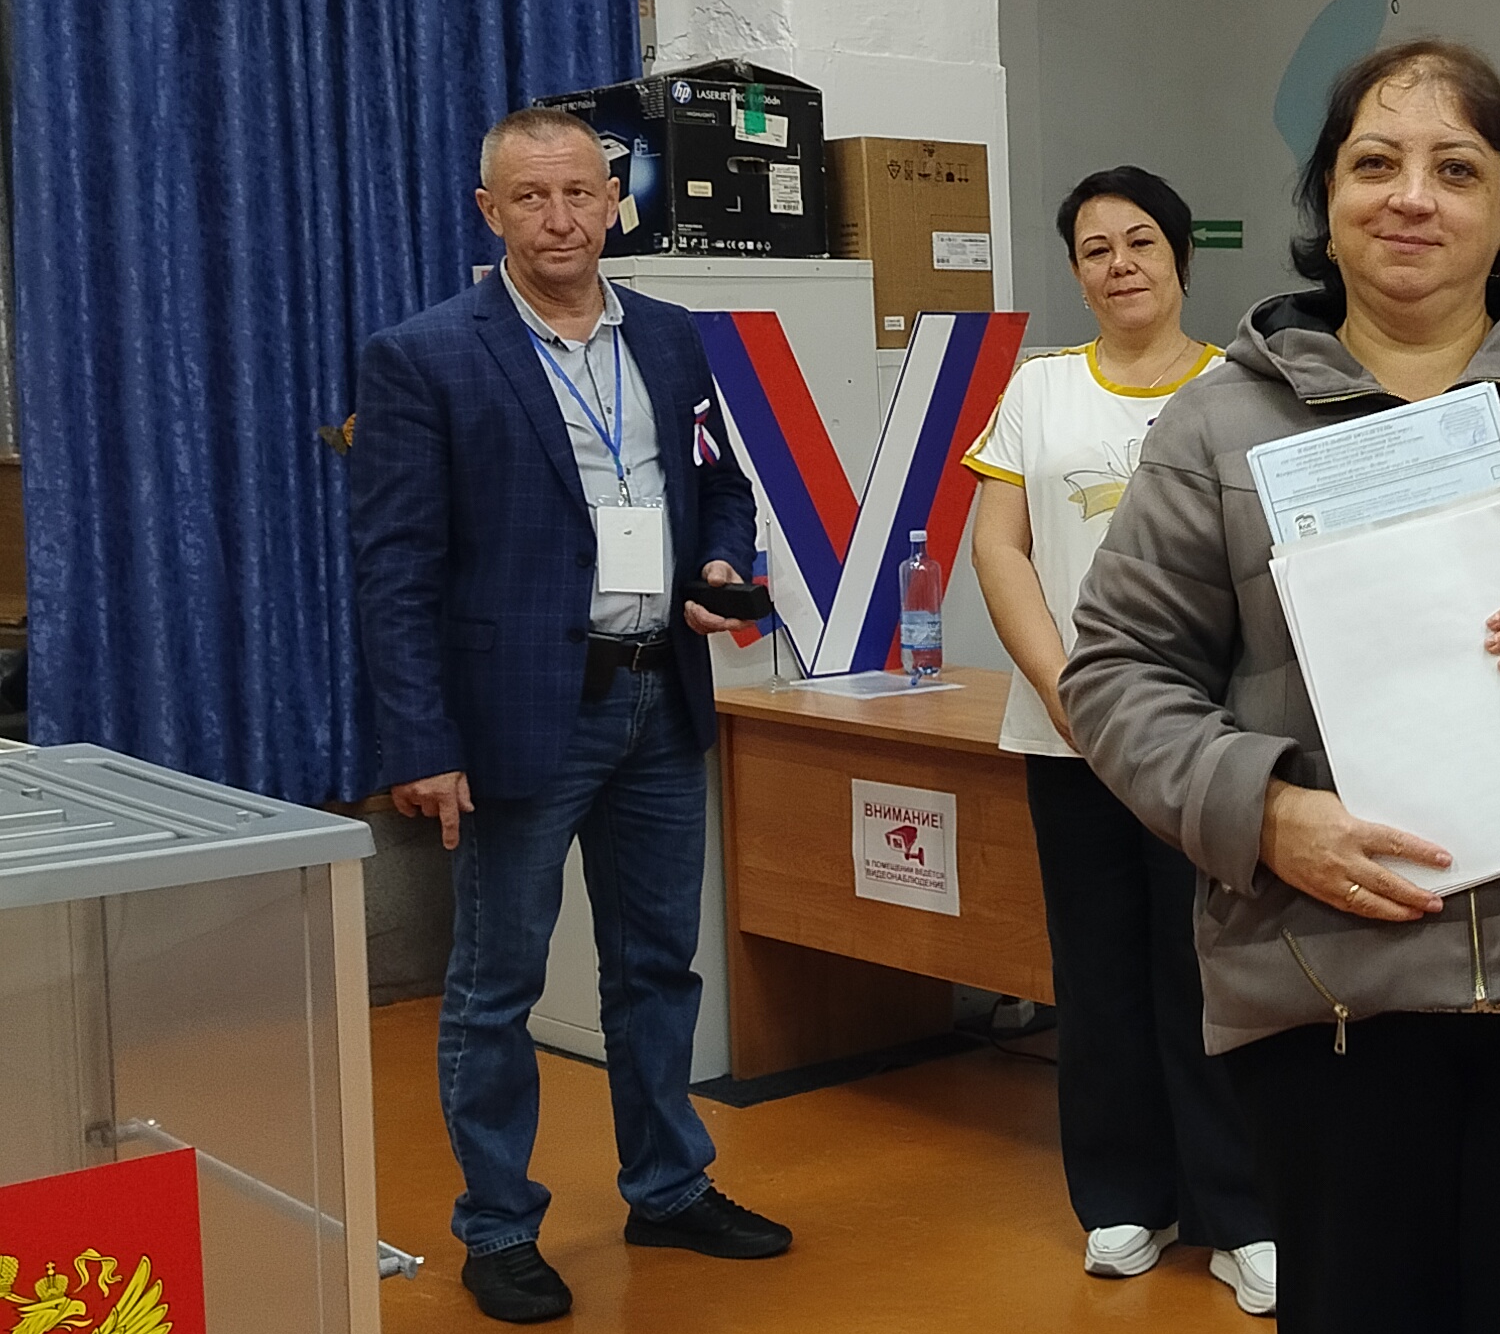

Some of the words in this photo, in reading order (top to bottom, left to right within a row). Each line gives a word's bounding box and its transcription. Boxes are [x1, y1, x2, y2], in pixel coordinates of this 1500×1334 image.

[673, 80, 691, 103] hp
[865, 803, 943, 829] ВНИМАНИЕ!
[866, 867, 945, 890] ВИДЕОНАБЛЮДЕНИЕ
